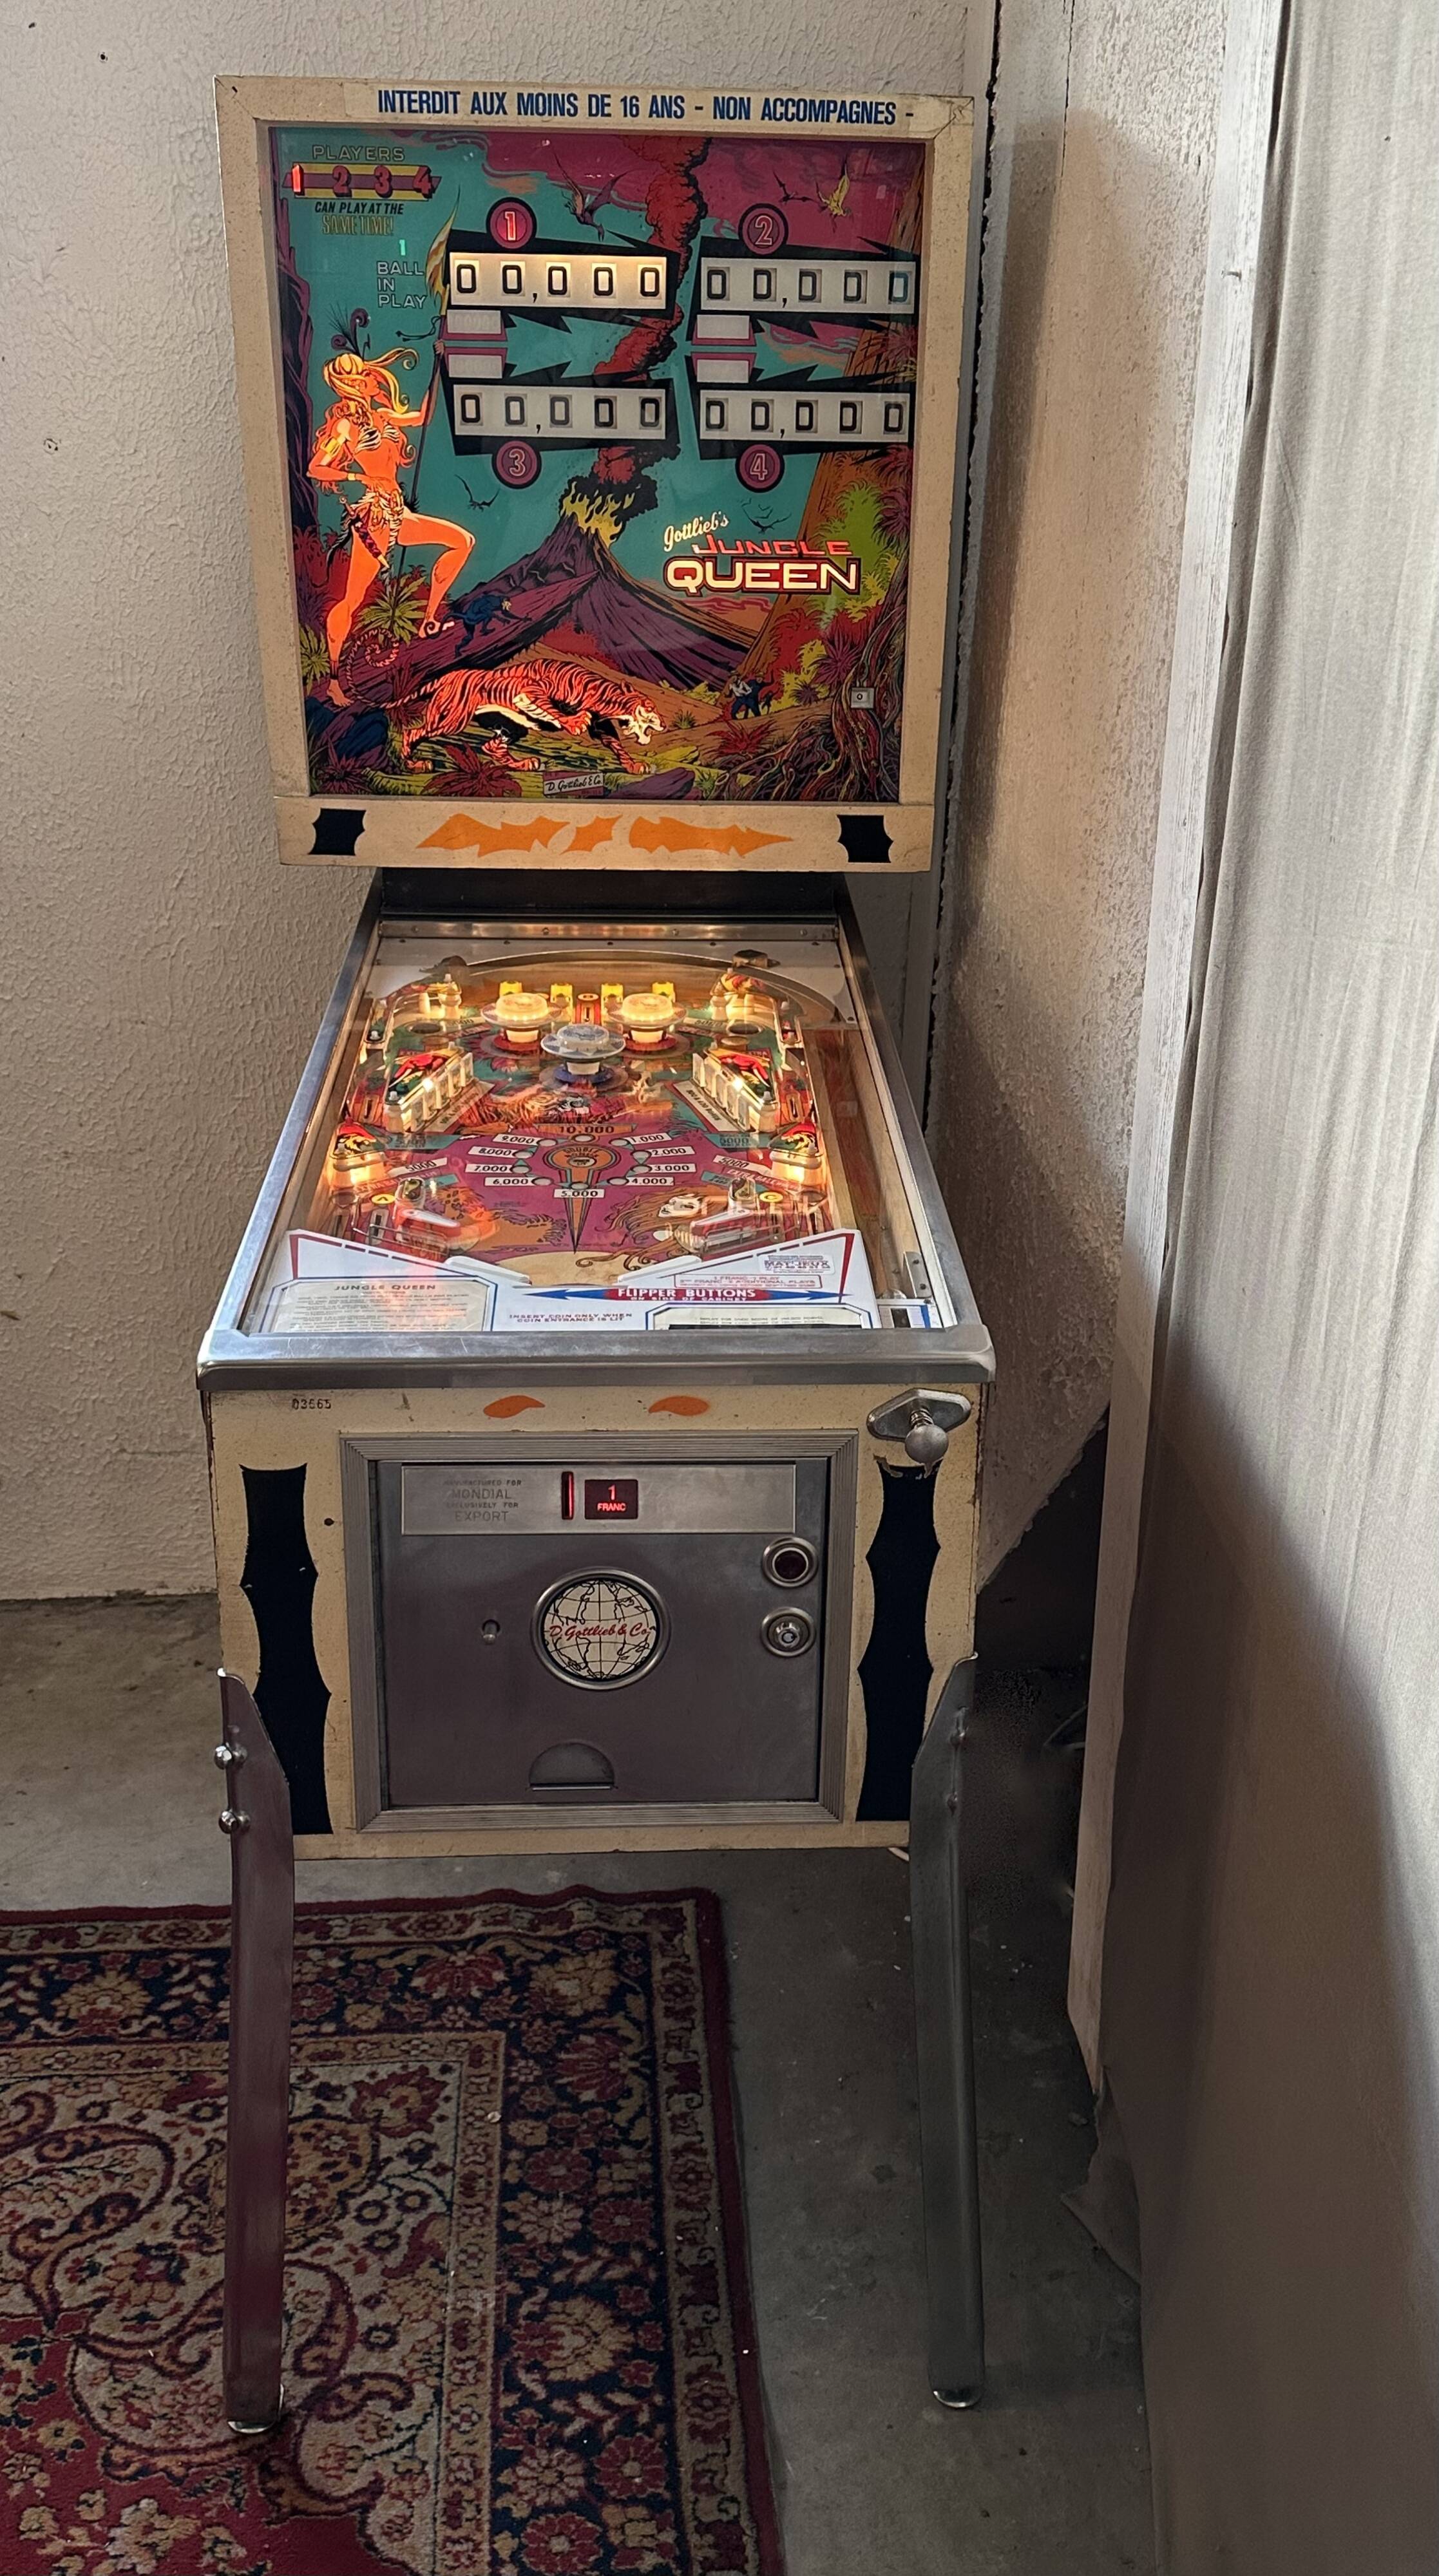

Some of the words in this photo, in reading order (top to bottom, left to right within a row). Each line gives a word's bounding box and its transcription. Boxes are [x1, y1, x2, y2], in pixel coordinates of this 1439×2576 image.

[377, 90, 461, 114] INTERDIT
[470, 91, 508, 116] AUX
[517, 92, 578, 117] MOINS
[587, 93, 612, 118] DE
[620, 95, 640, 118] 16
[648, 95, 685, 119] ANS
[712, 96, 751, 120] NON
[761, 97, 897, 125] ACCOMPAGNES
[312, 145, 405, 161] PLAYERS
[332, 166, 351, 196] 2
[374, 165, 392, 197] 3
[413, 165, 432, 197] 4
[314, 202, 336, 214] CAN
[339, 202, 367, 214] PLAY
[368, 203, 382, 214] AT
[385, 204, 404, 215] THE
[323, 214, 357, 236] SAME
[504, 211, 516, 241] 1
[755, 215, 773, 245] 2
[399, 239, 406, 256] 1
[376, 261, 424, 276] BALL
[377, 278, 395, 292] IN
[378, 294, 428, 308] PLAY
[509, 448, 526, 477] 3
[749, 452, 768, 480] 4
[691, 534, 853, 556] JUNGLE
[665, 558, 857, 595] QUEEN
[718, 1157, 750, 1168] 5000
[618, 1288, 676, 1297] FLIPPER
[685, 1289, 756, 1298] BUTTONS
[451, 1488, 512, 1500] MONDIAL
[607, 1484, 615, 1501] 1
[454, 1510, 510, 1521] EXPORT
[597, 1502, 626, 1512] FRANC
[565, 1624, 616, 1641] Gottlieb
[618, 1624, 627, 1635] &
